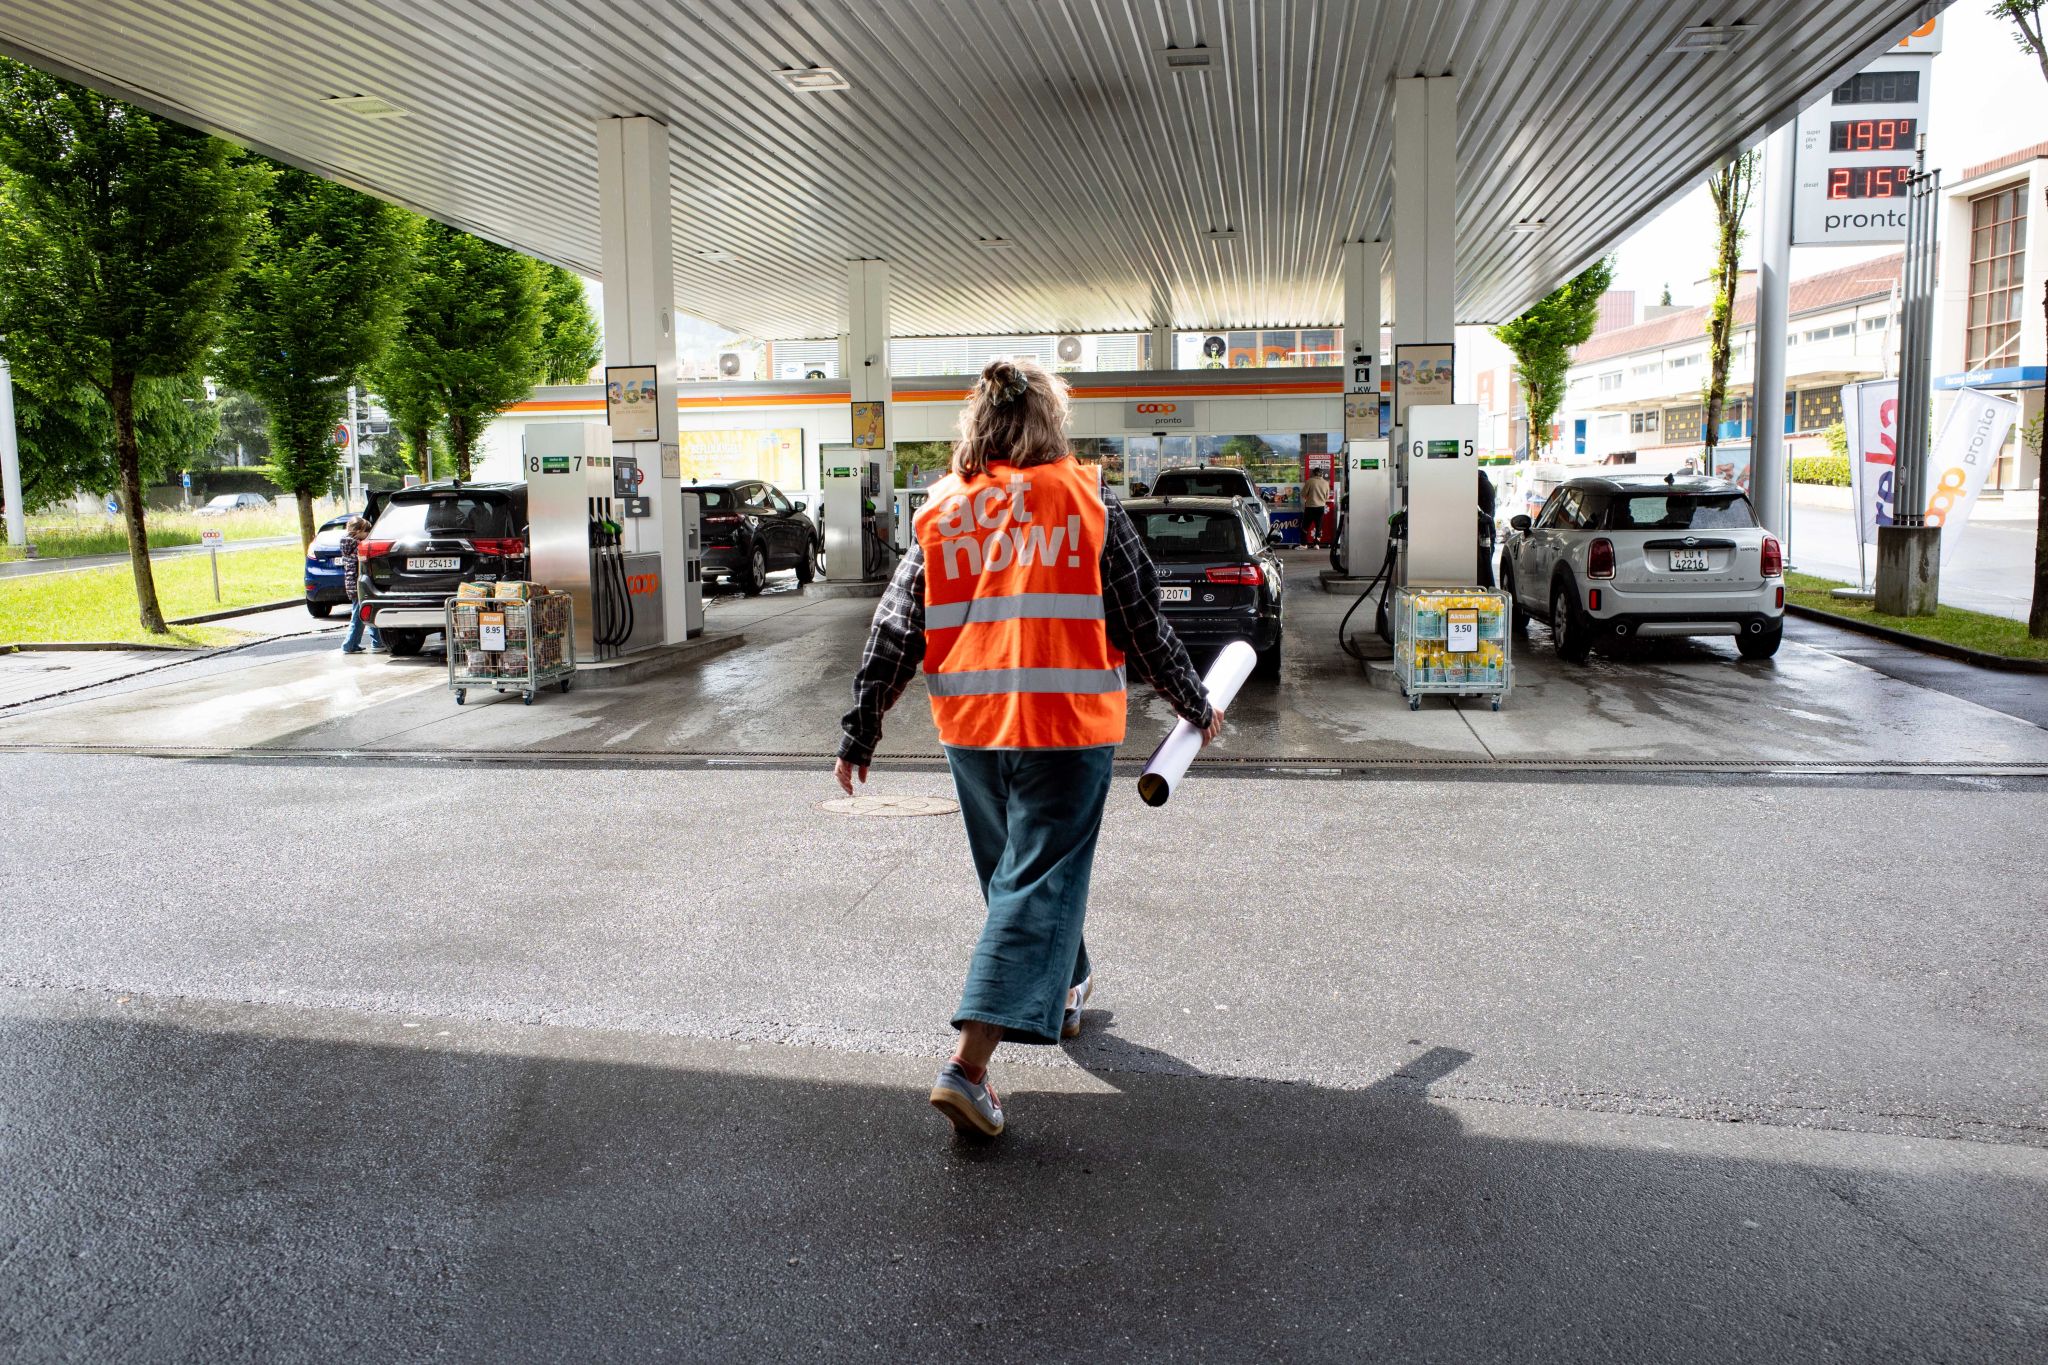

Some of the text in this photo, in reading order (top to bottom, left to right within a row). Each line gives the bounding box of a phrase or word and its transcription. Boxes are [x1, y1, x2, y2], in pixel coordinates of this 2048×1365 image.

[1136, 403, 1177, 416] coop
[1155, 417, 1182, 425] pronto
[1963, 408, 1996, 467] pronto
[1412, 440, 1474, 458] 6 5
[530, 456, 582, 473] 8 7
[1352, 459, 1359, 469] 2
[1381, 458, 1387, 469] 1
[825, 468, 832, 478] 4
[852, 467, 858, 477] 3
[1924, 467, 1967, 527] oop
[938, 473, 1032, 537] act
[942, 515, 1081, 580] now!
[1684, 550, 1694, 558] LU
[1675, 559, 1704, 570] 42216
[627, 573, 658, 597] coop
[485, 626, 501, 634] 8.95
[1454, 624, 1472, 633] 3.50
